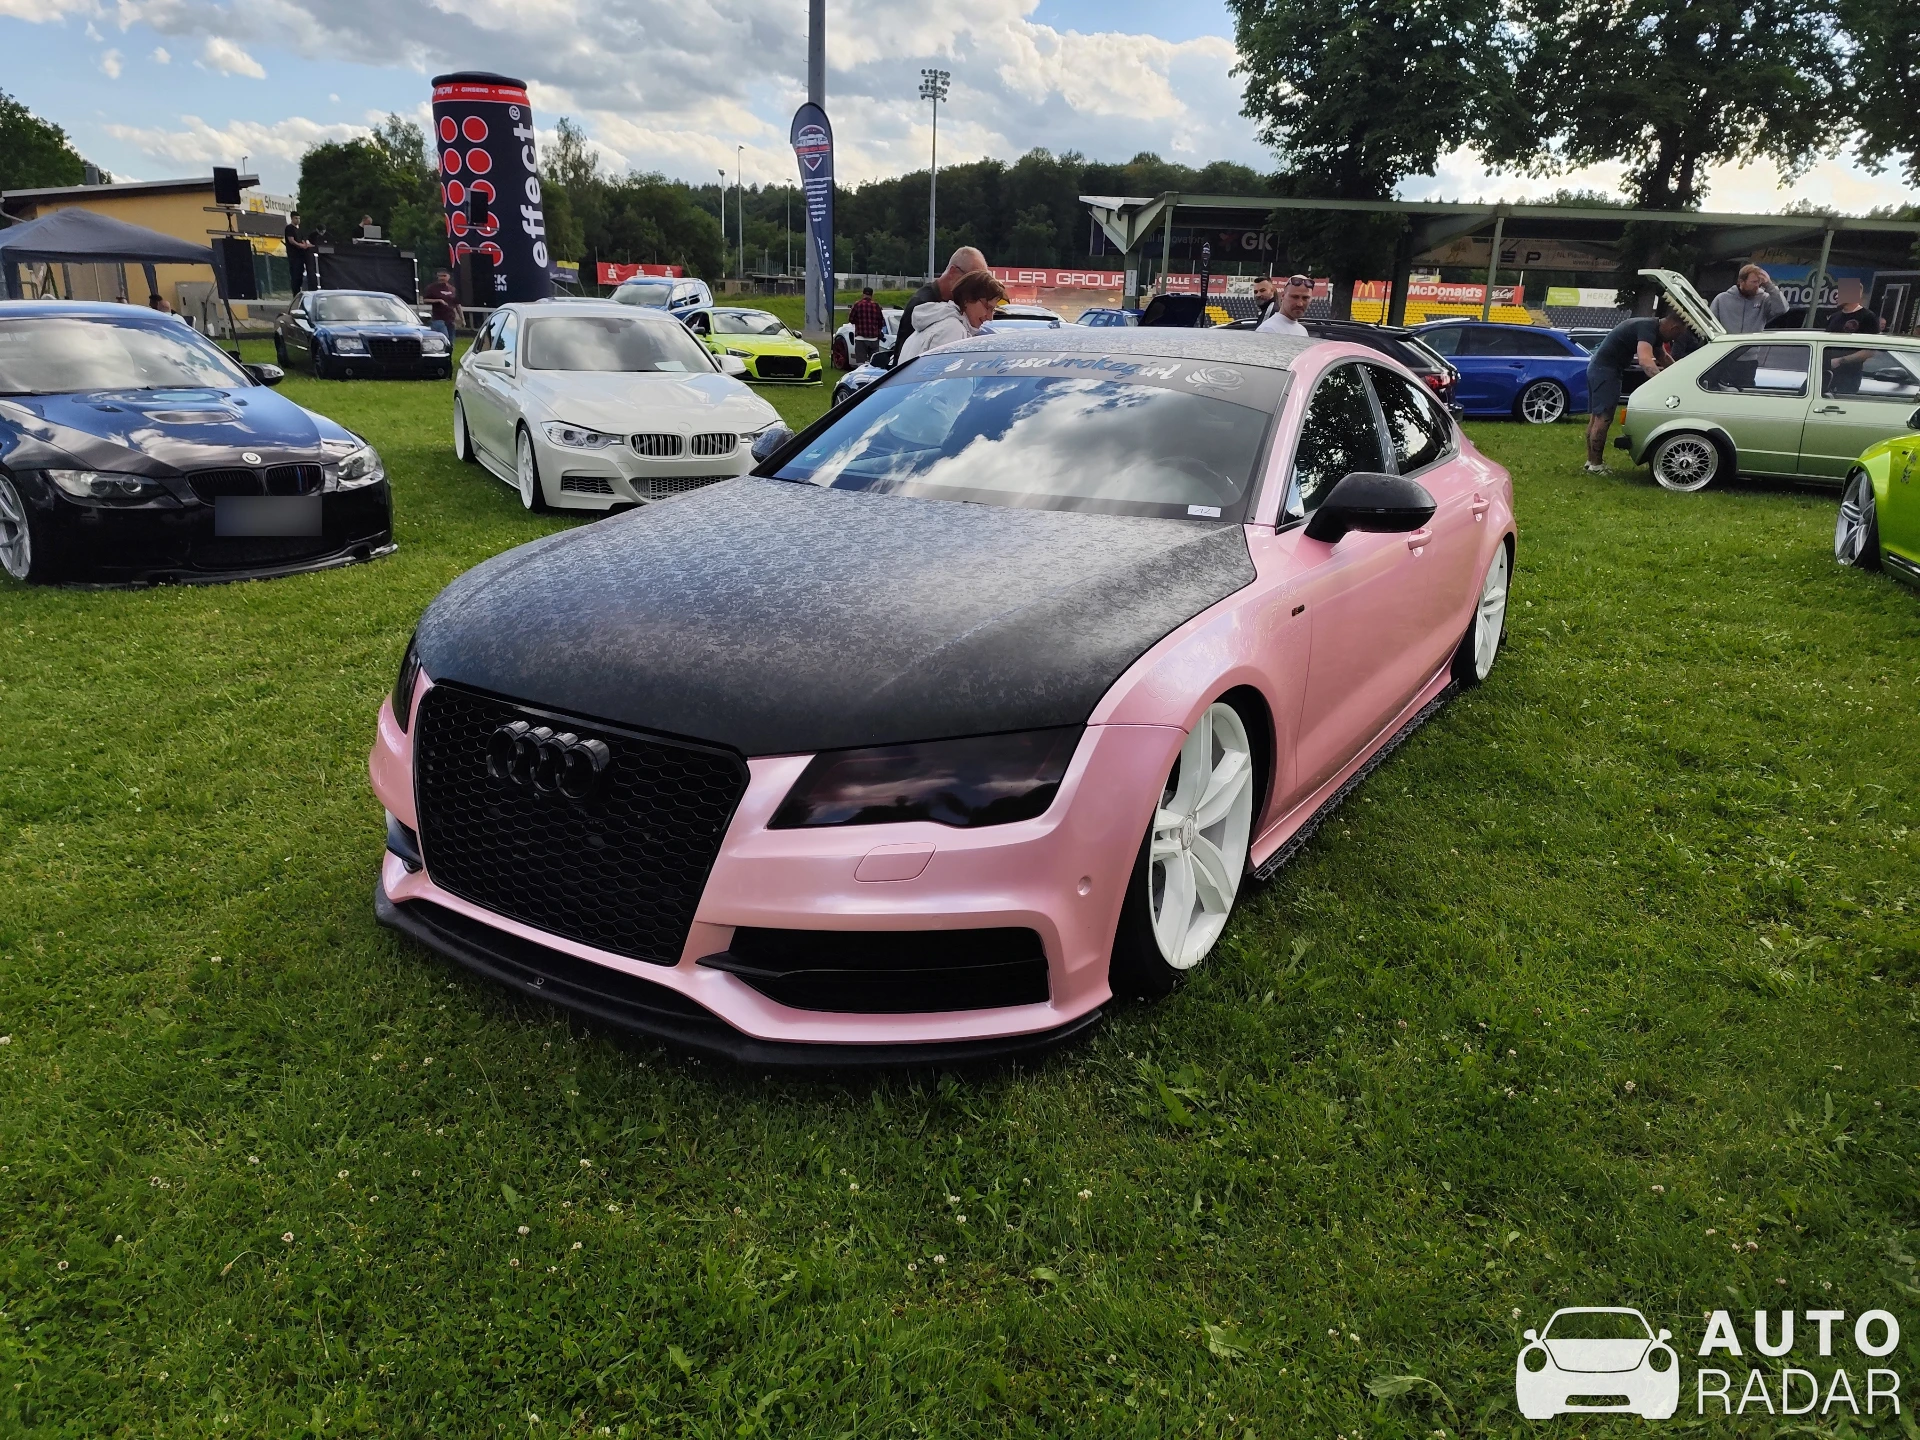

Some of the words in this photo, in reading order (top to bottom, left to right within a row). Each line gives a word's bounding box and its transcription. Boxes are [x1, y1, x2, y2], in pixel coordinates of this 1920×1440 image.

[1241, 232, 1274, 251] GK
[987, 270, 1047, 284] LLER
[1407, 284, 1483, 298] McDonald's
